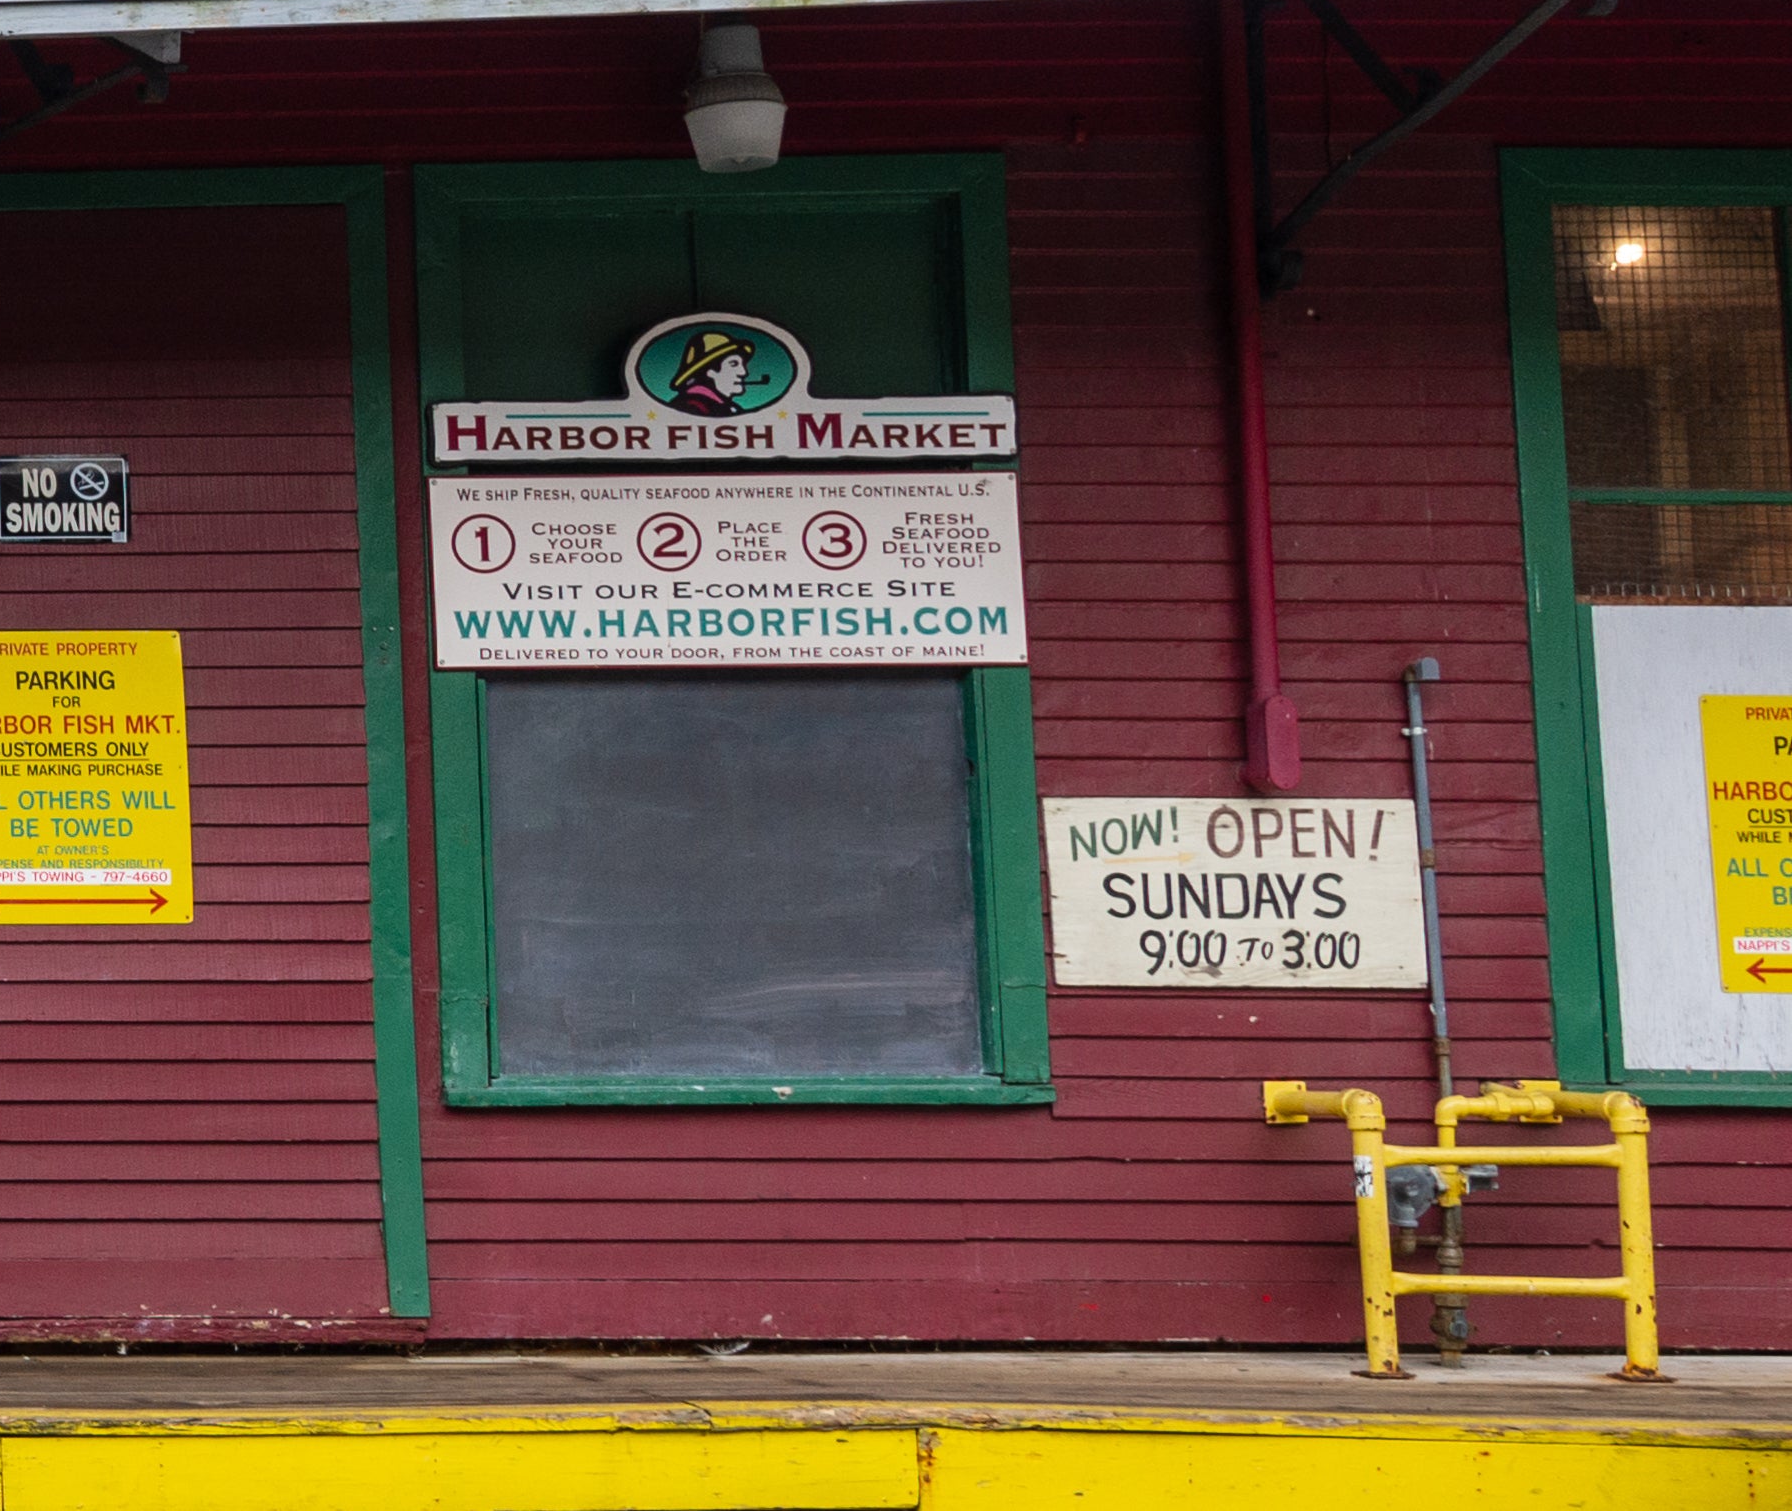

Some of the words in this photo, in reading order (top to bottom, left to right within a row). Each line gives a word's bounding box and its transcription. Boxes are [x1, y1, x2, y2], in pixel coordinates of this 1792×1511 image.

[446, 414, 651, 452] HARBOR
[668, 424, 775, 451] FISH
[797, 412, 1007, 449] MARKET
[22, 468, 57, 498] NO
[457, 488, 480, 501] WE
[485, 489, 518, 501] SHIP
[524, 488, 575, 501] FRESH,
[580, 488, 640, 501] QUALITY
[645, 488, 710, 500] SEAFOOD
[715, 487, 794, 499] ANYWHERE
[799, 486, 814, 498] IN
[819, 486, 847, 498] THE
[851, 484, 953, 498] CONTINENTAL
[958, 483, 990, 497] U.S.
[5, 502, 120, 533] SMOKING
[905, 512, 974, 525] FRESH
[531, 522, 617, 535] CHOOSE
[717, 521, 782, 534] PLACE
[892, 526, 989, 539] SEAFOOD
[475, 526, 491, 563] 1
[547, 538, 603, 550] YOUR
[652, 522, 688, 558] 2
[732, 536, 770, 548] THE
[819, 522, 853, 558] 3
[883, 541, 1001, 554] DELIVERED
[529, 552, 623, 564] SEAFOOD
[715, 550, 787, 563] ORDER
[900, 557, 925, 568] TO
[935, 554, 984, 568] YOU!
[502, 582, 583, 600] VISIT
[595, 584, 658, 599] OUR
[672, 581, 873, 599] E-COMMERCE
[887, 579, 955, 597] SITE
[454, 606, 1008, 639] WWW.HARBORFISH.COM
[56, 642, 138, 656] PROPERTY
[479, 647, 580, 660] DELIVERED
[587, 648, 608, 659] TO
[615, 648, 663, 659] YOUR
[671, 647, 724, 660] DOOR,
[733, 646, 781, 658] FROM
[788, 646, 823, 657] THE
[829, 646, 884, 657] COAST
[892, 646, 915, 657] OF
[922, 644, 985, 656] MAINE!
[16, 670, 115, 690] PARKING
[52, 696, 81, 708] FOR
[63, 715, 114, 734] FISH
[125, 715, 180, 734] MKT.
[106, 741, 149, 757] ONLY
[27, 764, 82, 776] MAKING
[88, 764, 163, 776] PURCHASE
[18, 790, 111, 810] OTHERS
[122, 791, 176, 810] WILL
[10, 818, 39, 837] BE
[50, 818, 133, 837] TOWED
[1069, 806, 1179, 862] NOW!
[1206, 805, 1385, 862] OPEN!
[1736, 831, 1782, 843] WHILE
[1726, 858, 1769, 877] ALL
[32, 871, 84, 882] TOWING
[103, 871, 168, 882] 797-4660
[1102, 872, 1347, 920] SUNDAYS
[1139, 929, 1227, 976] 9:00
[1282, 929, 1360, 969] 3:00
[1738, 940, 1791, 951] NAPPI'S
